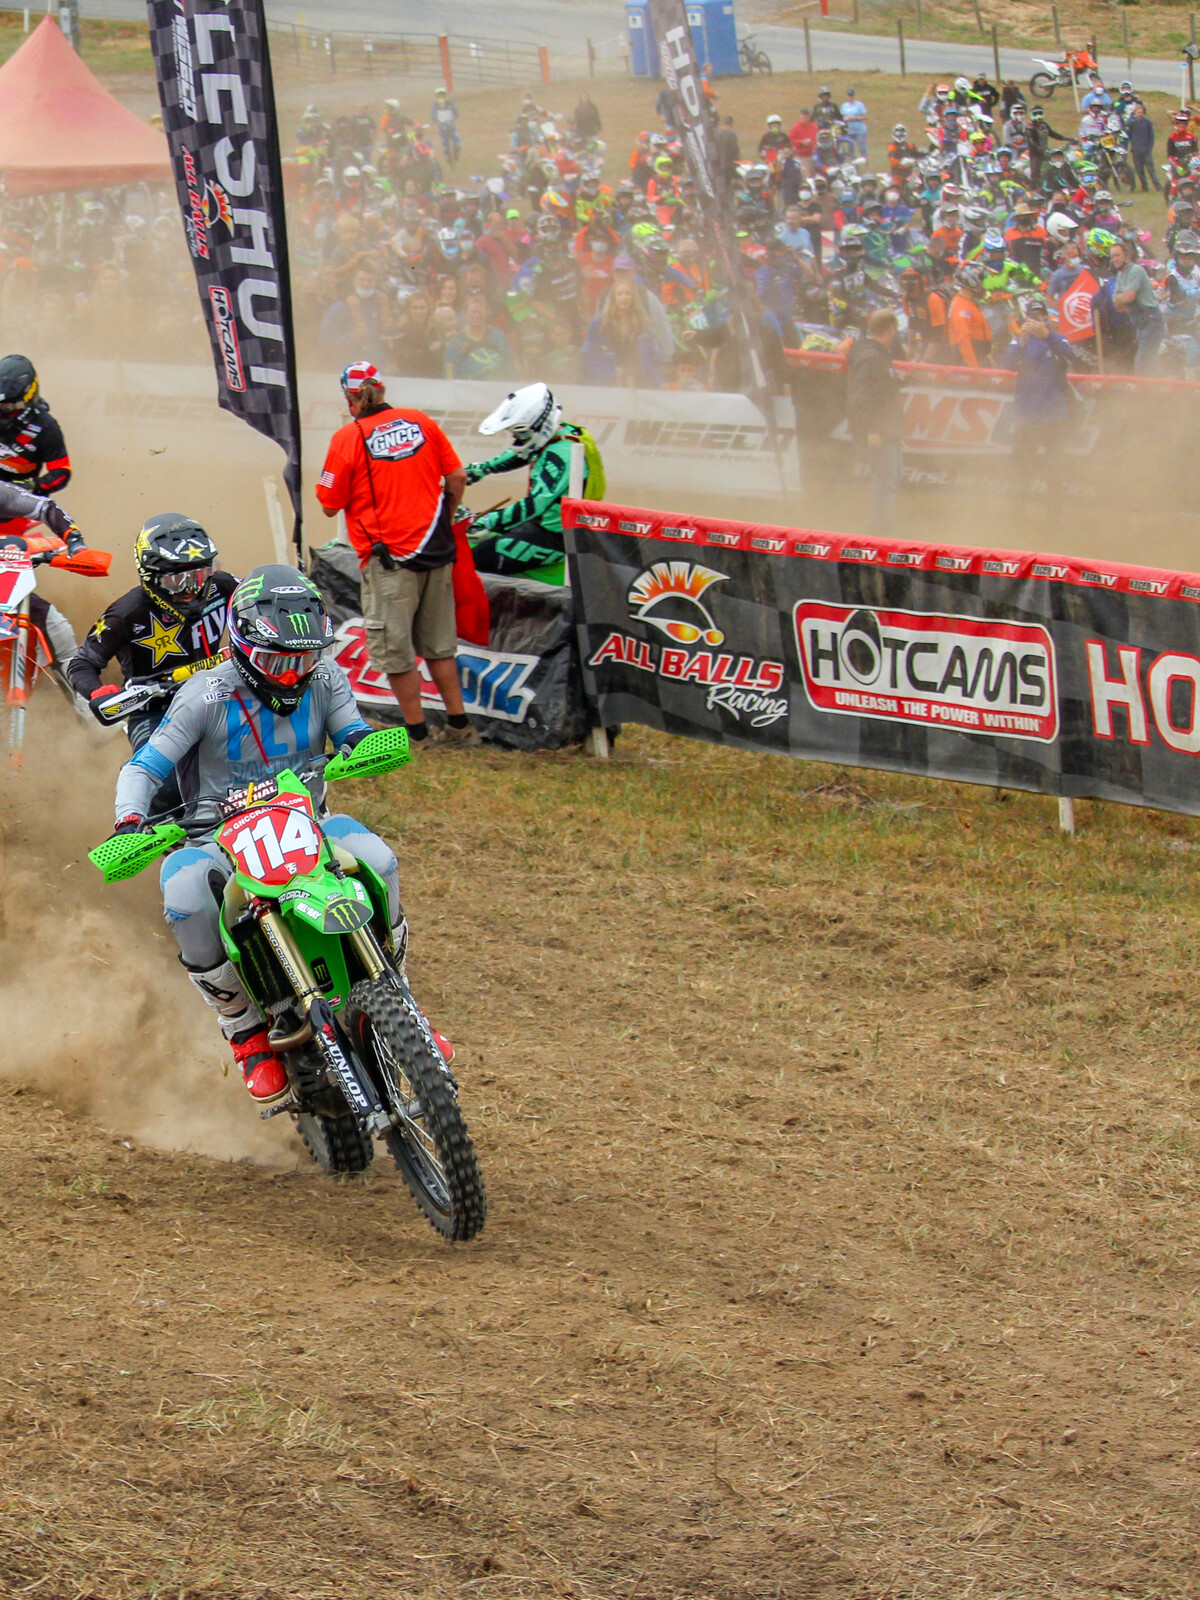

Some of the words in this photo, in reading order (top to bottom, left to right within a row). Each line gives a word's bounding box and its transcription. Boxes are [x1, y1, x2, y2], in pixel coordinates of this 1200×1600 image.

[372, 426, 419, 453] GNCC
[191, 605, 227, 650] FLY
[588, 633, 656, 672] ALL
[658, 648, 785, 693] BALLS
[809, 609, 1047, 708] HOTCAMS
[225, 684, 310, 761] FLY
[706, 682, 789, 728] Racing
[834, 690, 899, 713] UNLEASH
[901, 699, 929, 718] THE
[930, 703, 979, 725] POWER
[982, 712, 1041, 733] WITHIN
[345, 753, 393, 772] ACERBIS
[120, 837, 167, 865] ACERBIS
[231, 805, 319, 879] 114
[262, 922, 279, 947] PRO
[275, 946, 303, 991] CIRCUIT
